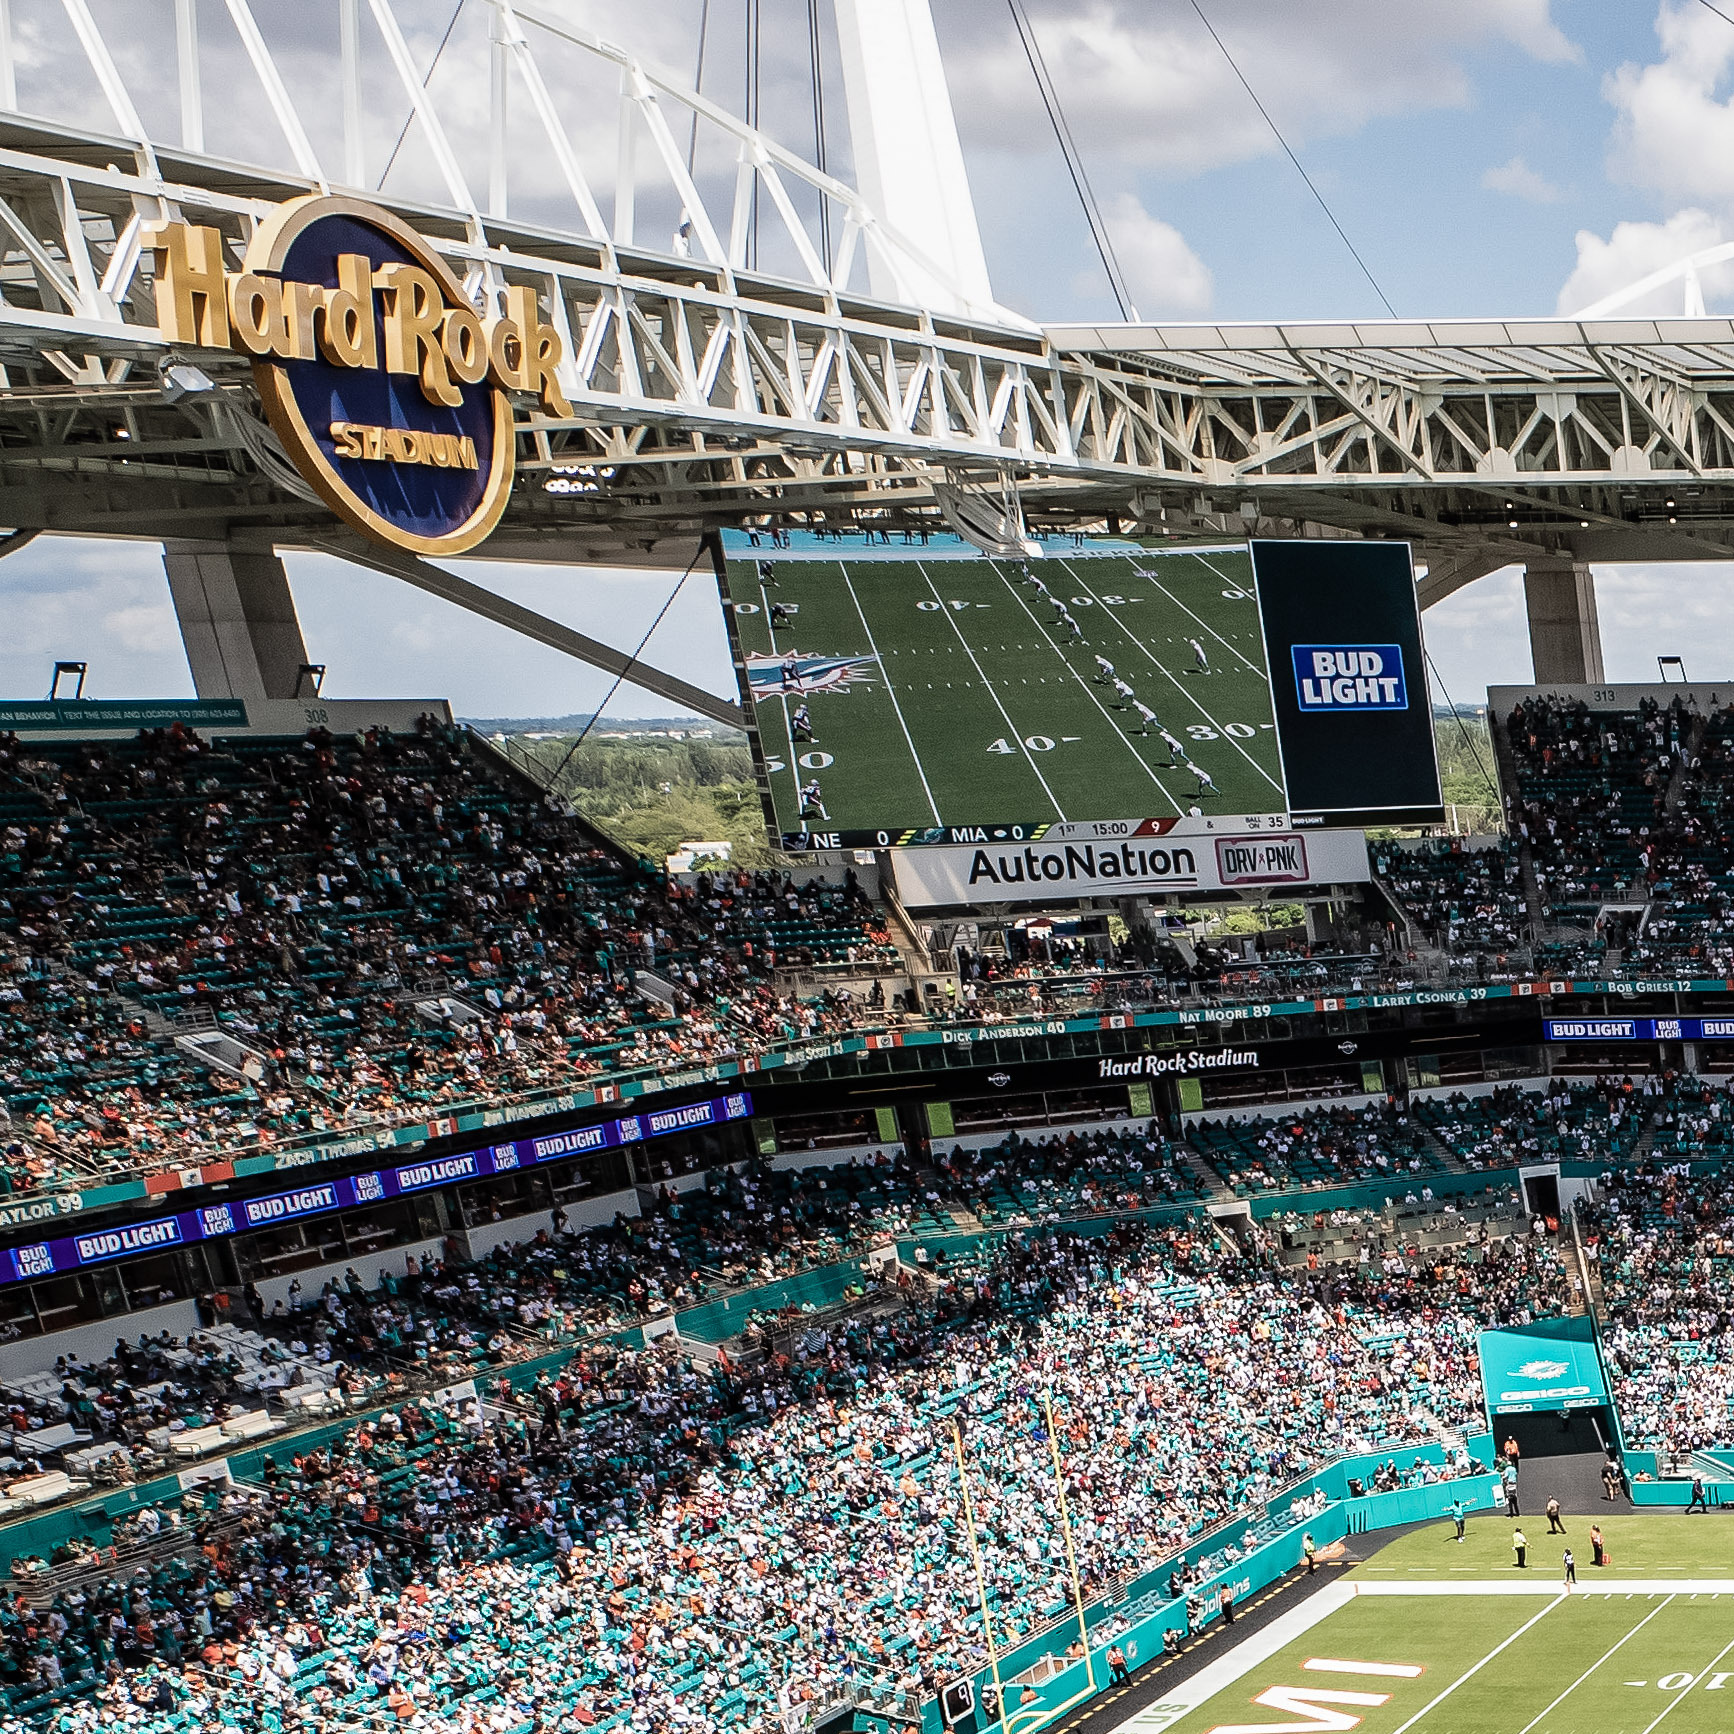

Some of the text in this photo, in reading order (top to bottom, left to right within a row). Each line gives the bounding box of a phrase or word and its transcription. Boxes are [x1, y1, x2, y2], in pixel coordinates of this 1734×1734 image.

[143, 218, 574, 420] Hard Rock
[329, 420, 481, 471] STADIUM
[1312, 651, 1383, 677] BUD
[1302, 678, 1398, 703] LIGHT
[1058, 822, 1128, 837] 1ST 15:00
[1151, 821, 1160, 833] 9
[1268, 816, 1284, 828] 35
[813, 831, 888, 849] NE 0
[952, 826, 1023, 842] MIA 0
[968, 843, 1196, 886] AutoNation
[1225, 845, 1298, 872] DRV PNK
[1608, 980, 1692, 992] BOB GRIESE 12
[1373, 988, 1487, 1008] LARRY CSONKA 39
[1179, 1005, 1271, 1024] NAT MOORE 89
[942, 1021, 1066, 1043] DICK ANDERSON 40
[1552, 1023, 1631, 1036] BUD LIGHT
[1099, 1049, 1259, 1078] Hard Rock Stadium
[399, 1156, 472, 1187] BUD LIGHT
[56, 1193, 84, 1213] 99
[248, 1187, 332, 1221] BUD LIGHT
[78, 1221, 176, 1258] BUD LIGHT
